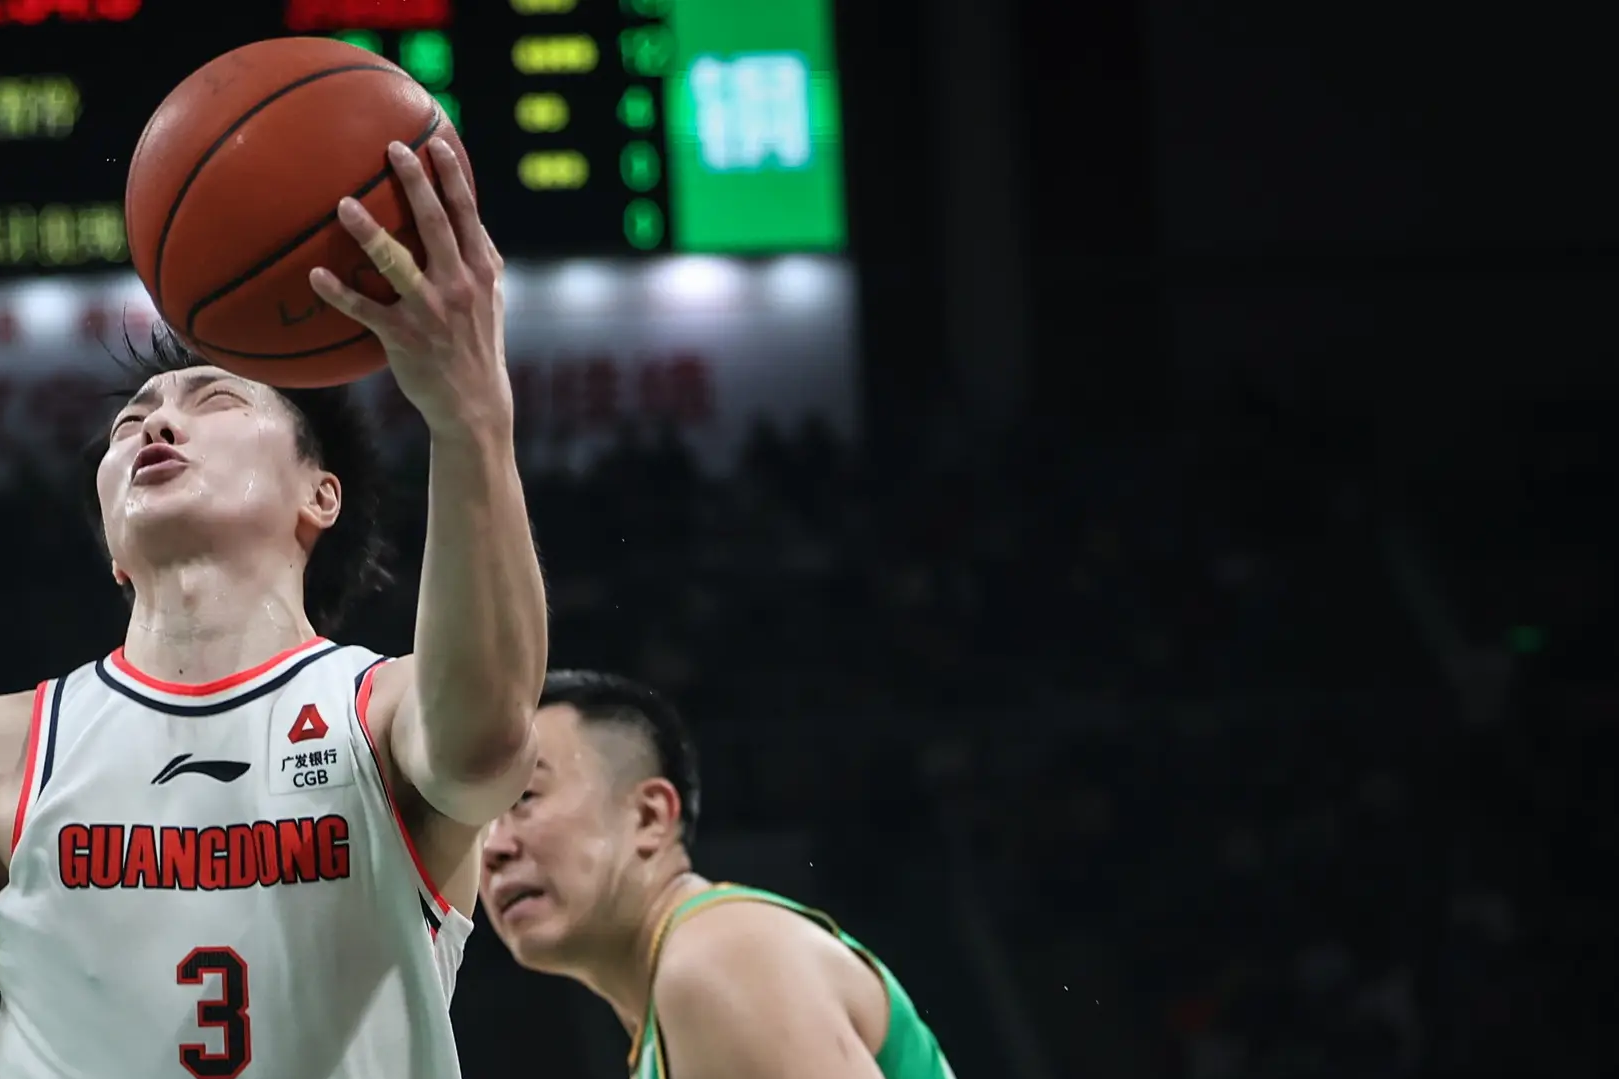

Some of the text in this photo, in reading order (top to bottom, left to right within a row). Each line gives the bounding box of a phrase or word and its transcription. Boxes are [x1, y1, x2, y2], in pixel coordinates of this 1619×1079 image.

[281, 748, 337, 772] 广发银行
[293, 769, 329, 788] CGB
[58, 814, 350, 891] GUANGDONG
